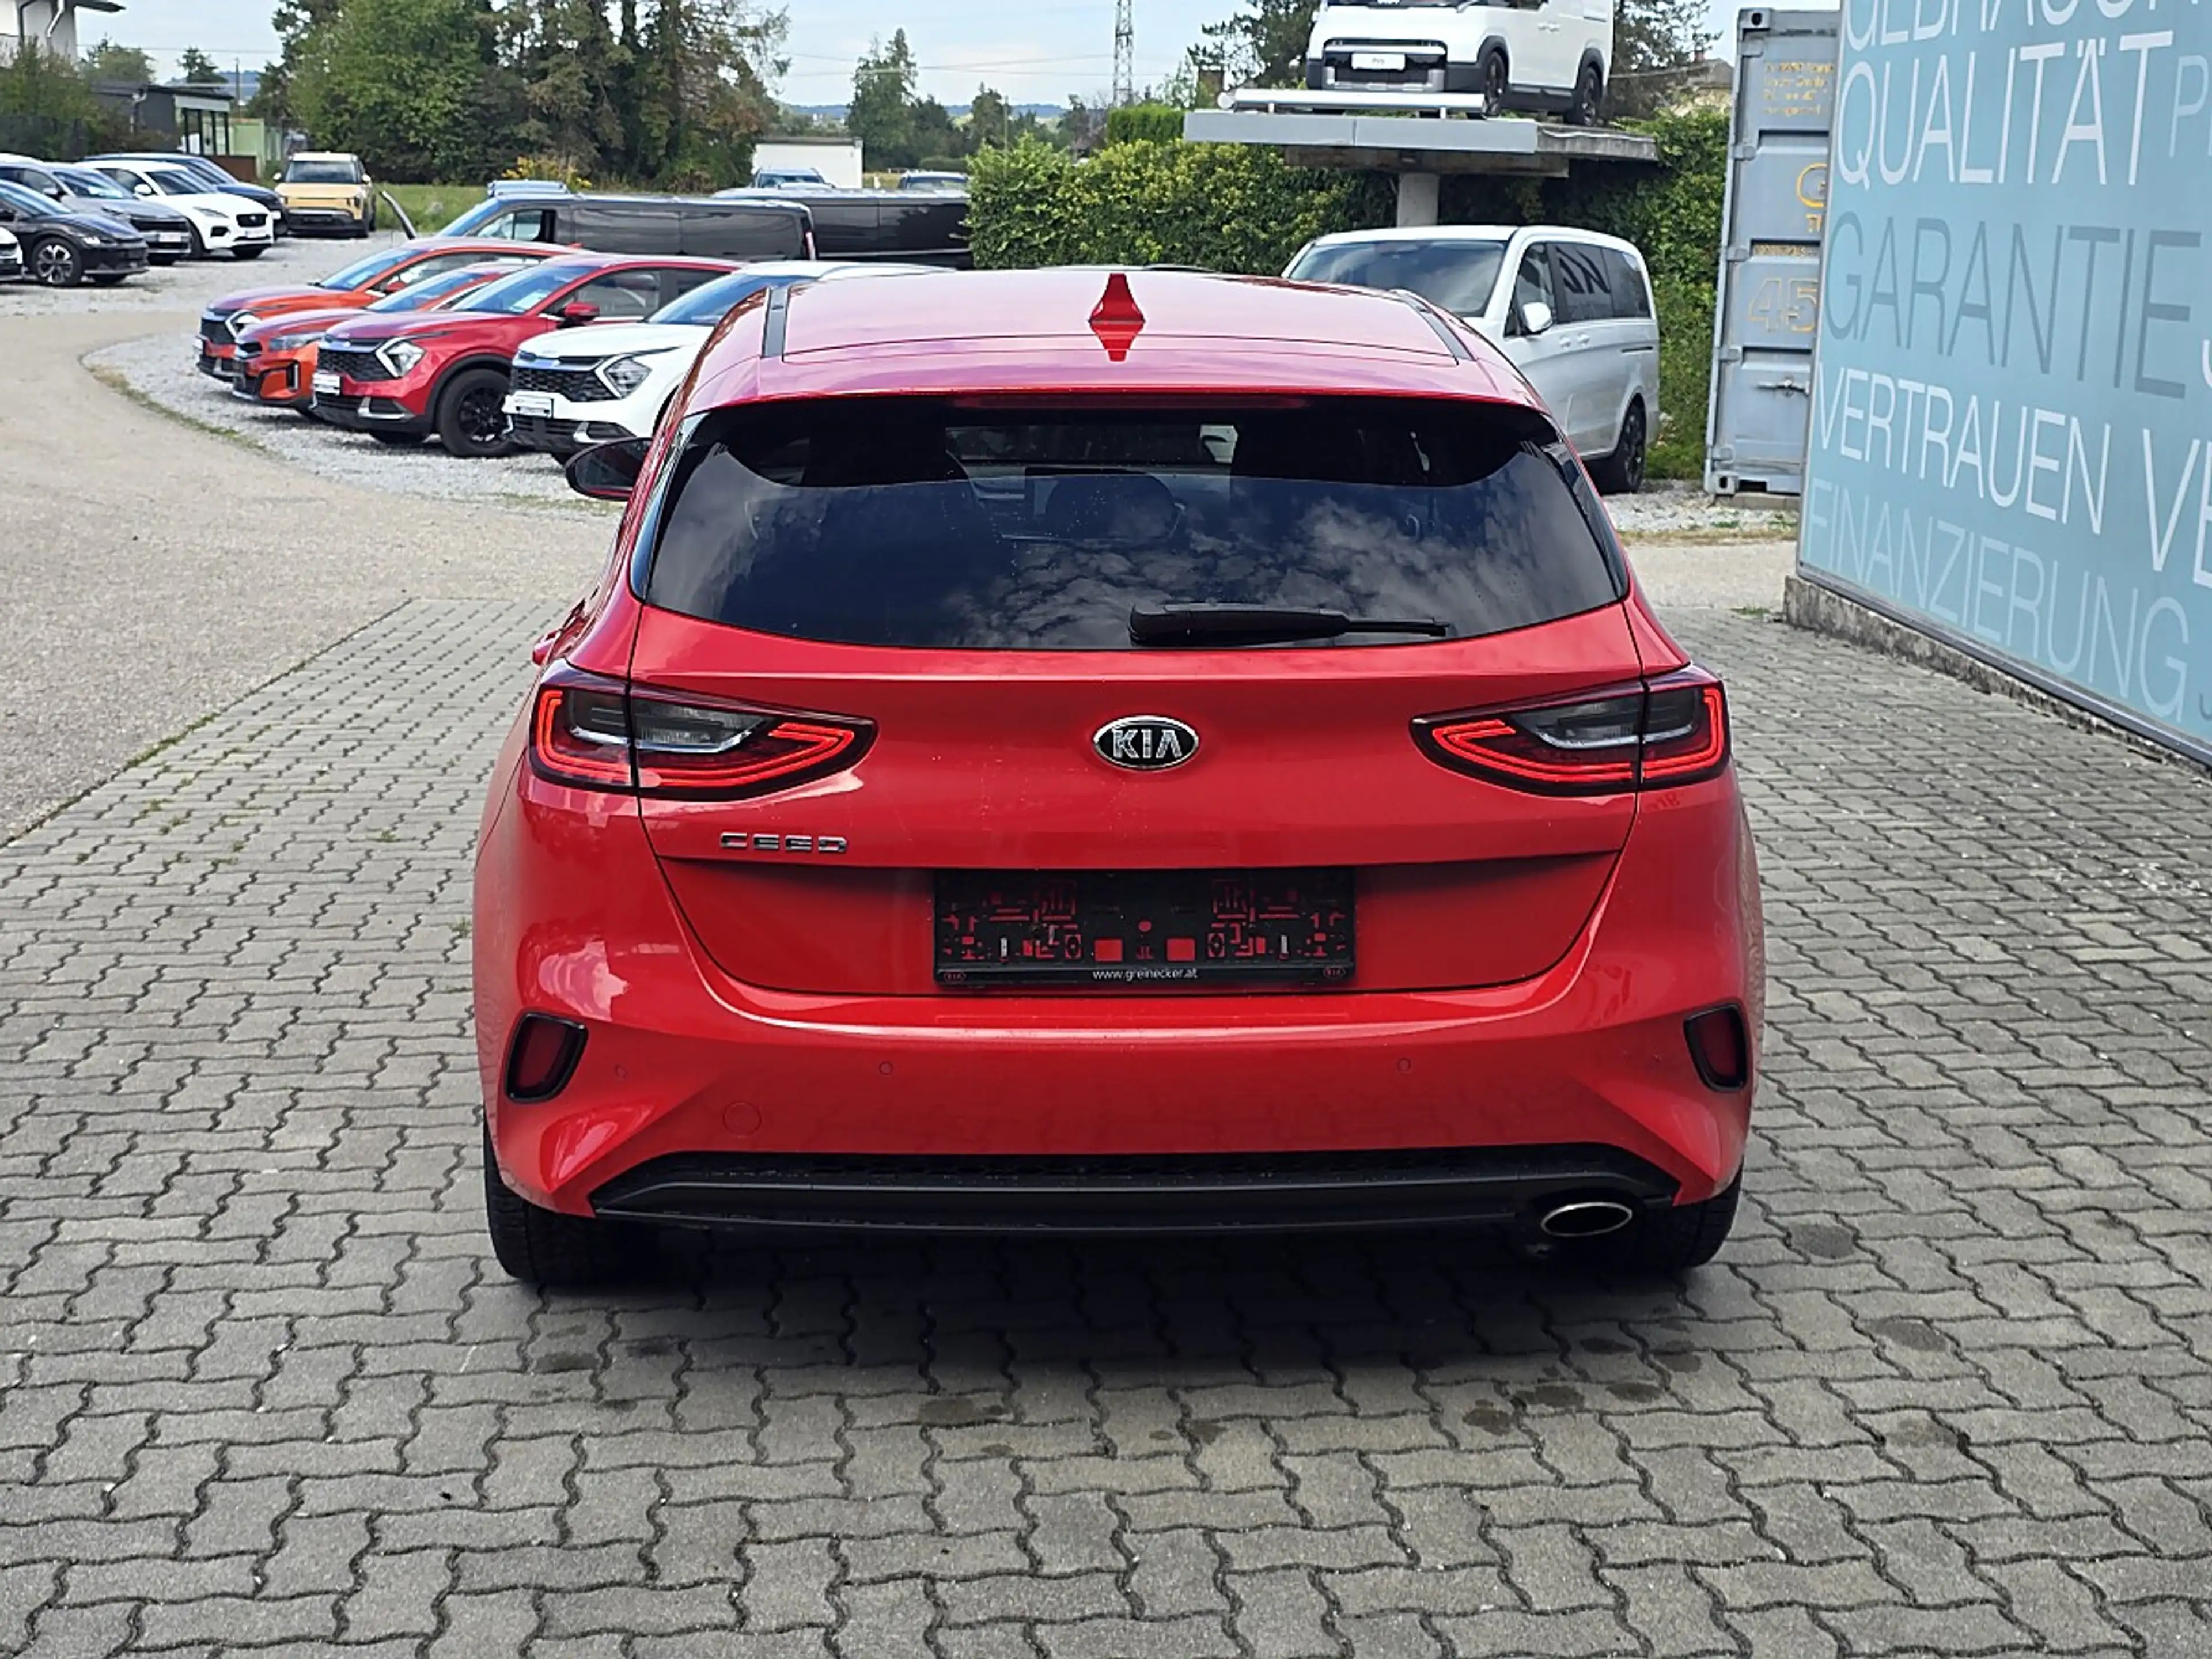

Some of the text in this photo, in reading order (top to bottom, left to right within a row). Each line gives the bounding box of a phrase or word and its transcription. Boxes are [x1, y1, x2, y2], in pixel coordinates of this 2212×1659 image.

[1838, 30, 2173, 190] QUALITÄT
[1825, 211, 2202, 399] GARANTIE
[1819, 362, 2111, 535] VERTRAUEN
[1806, 477, 2189, 723] FINANZIERUNG
[1112, 729, 1183, 759] KIA
[721, 832, 847, 852] CEED
[1092, 968, 1198, 982] www.greinecker.at
